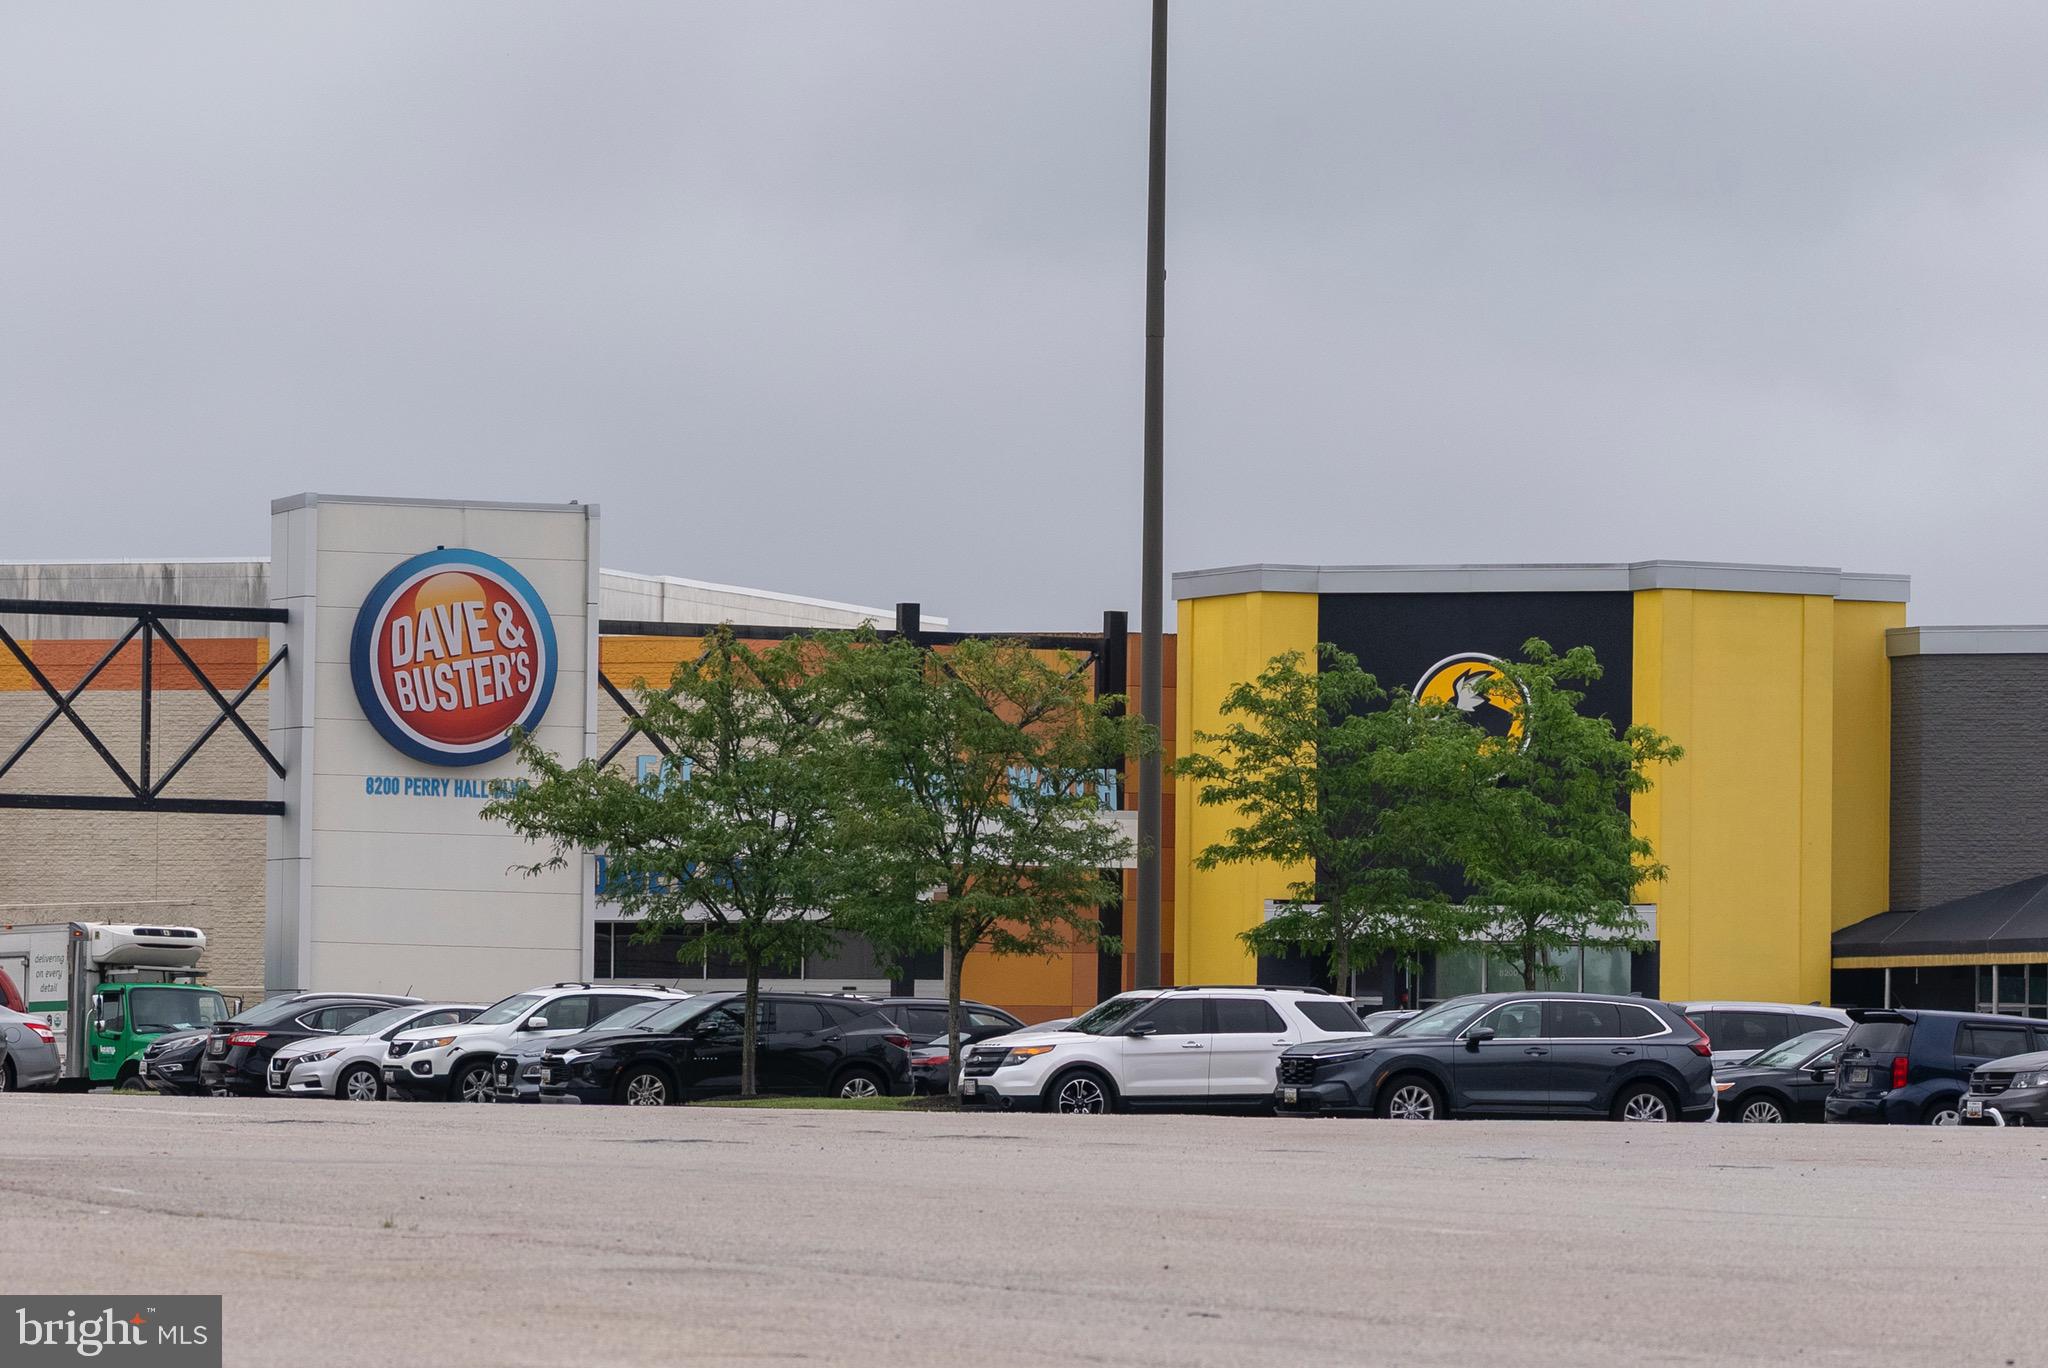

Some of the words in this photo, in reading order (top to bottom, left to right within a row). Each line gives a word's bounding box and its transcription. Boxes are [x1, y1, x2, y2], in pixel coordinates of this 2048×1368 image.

[391, 600, 494, 668] DAVE
[493, 602, 528, 650] &
[393, 650, 531, 713] BUSTER'S
[365, 776, 400, 796] 8200
[404, 777, 450, 797] PERRY
[454, 779, 489, 799] HALL
[35, 954, 64, 965] delivering
[36, 970, 44, 978] on
[45, 970, 63, 980] every
[40, 982, 58, 993] detail
